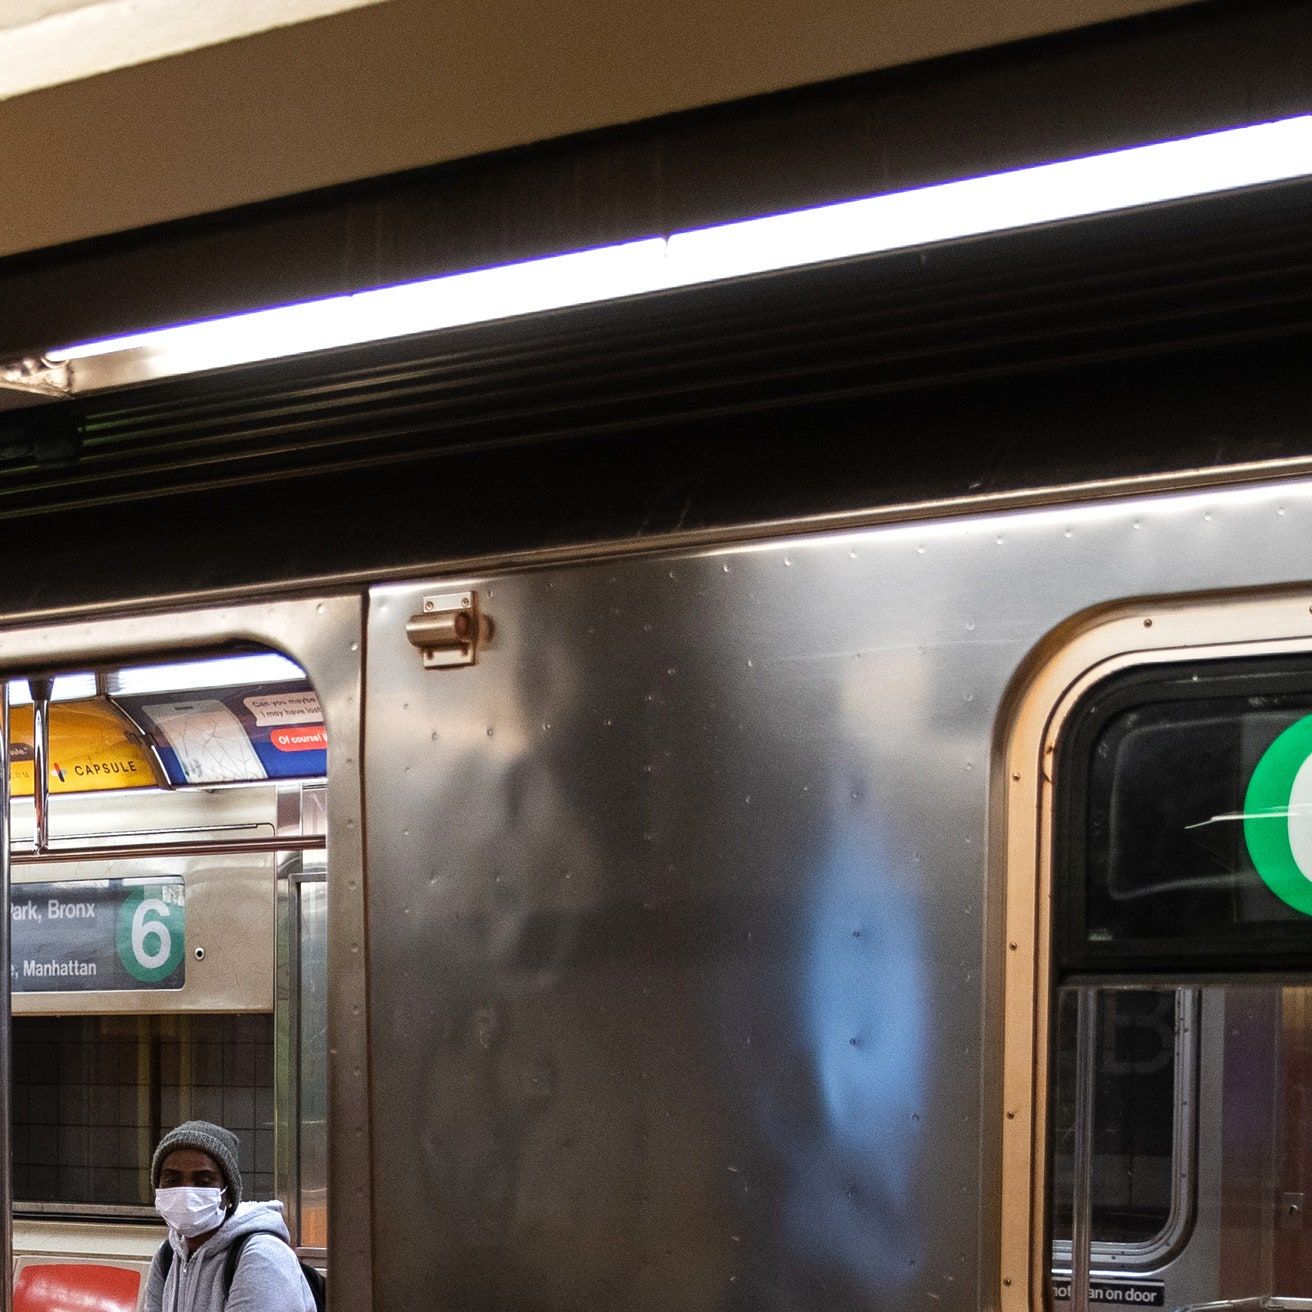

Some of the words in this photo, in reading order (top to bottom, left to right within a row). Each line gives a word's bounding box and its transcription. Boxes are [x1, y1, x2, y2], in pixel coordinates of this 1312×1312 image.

[278, 736, 290, 744] Of
[74, 761, 137, 776] CAPSULE
[48, 900, 95, 919] Bronx
[132, 899, 171, 968] 6
[24, 960, 96, 976] Manhattan
[1089, 1289, 1103, 1299] an
[1106, 1290, 1122, 1300] on
[1125, 1288, 1157, 1302] door
